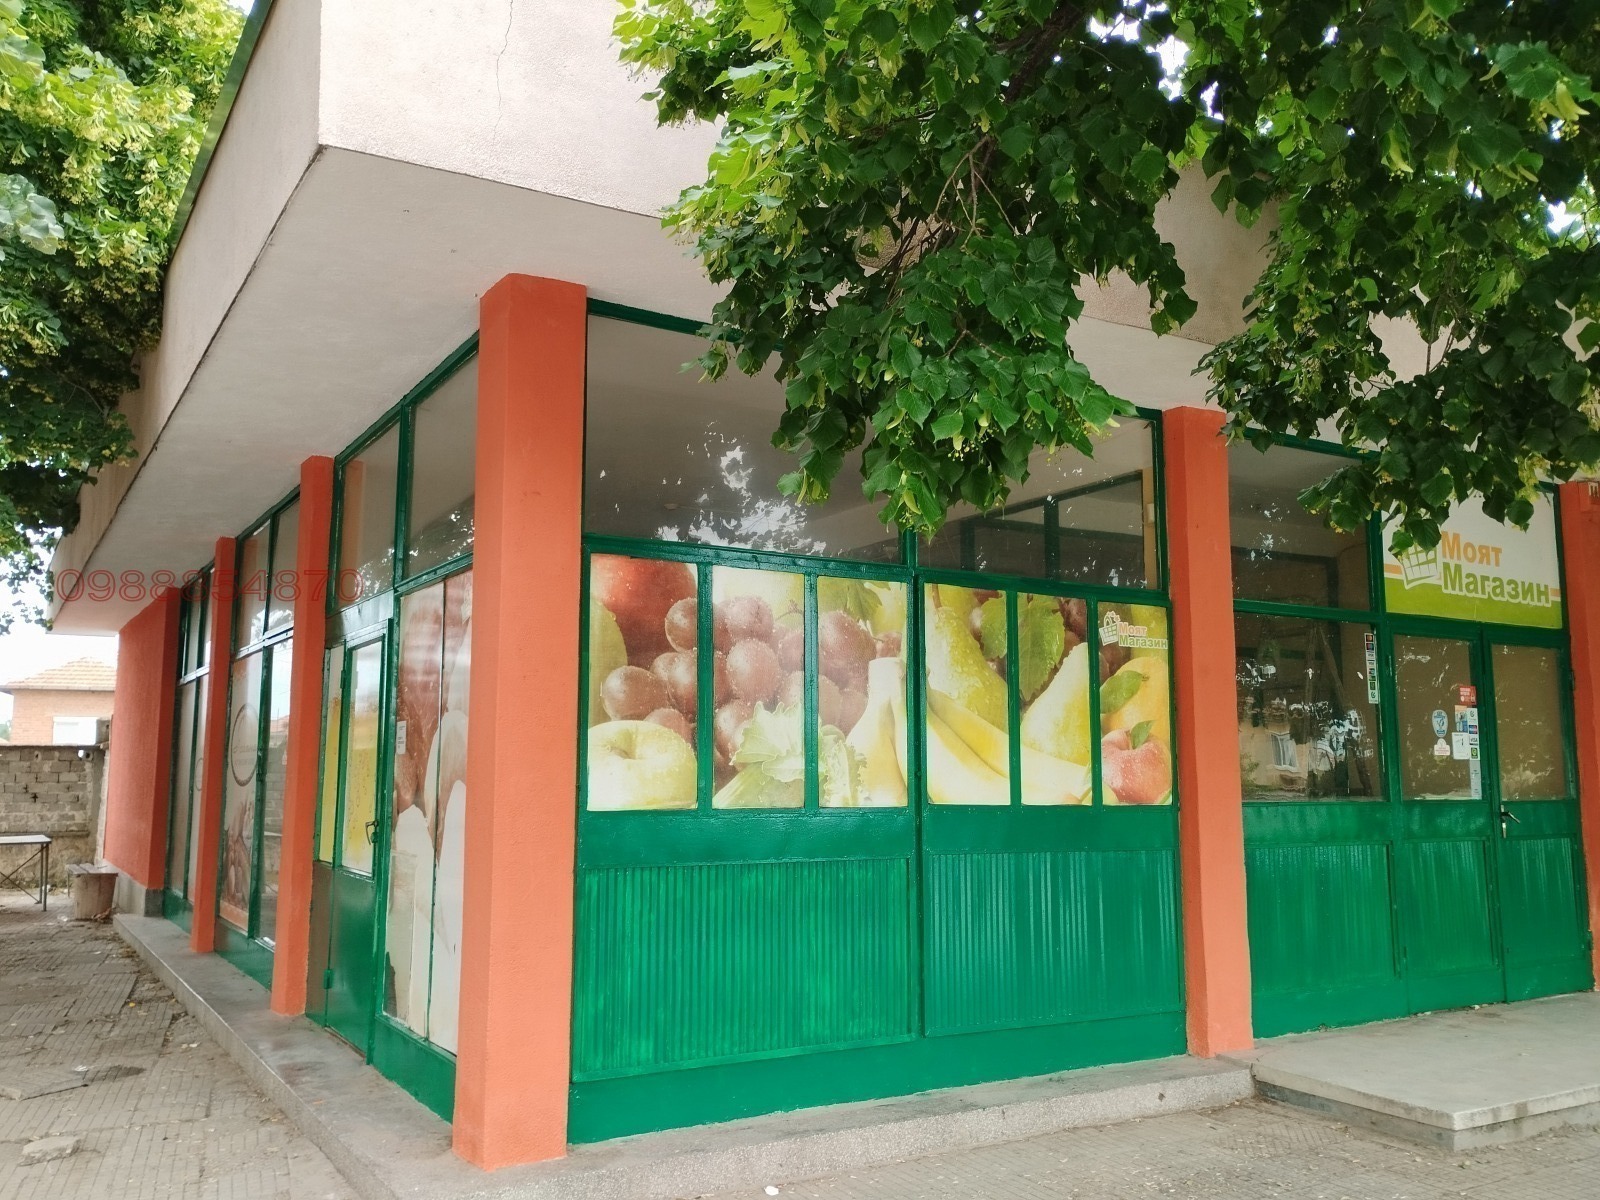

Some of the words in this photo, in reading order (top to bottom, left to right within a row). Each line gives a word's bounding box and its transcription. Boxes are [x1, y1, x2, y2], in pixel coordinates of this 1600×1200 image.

[1441, 530, 1502, 567] Моят
[1442, 562, 1549, 605] Магазин
[1119, 622, 1147, 636] Моят
[1119, 635, 1168, 649] Магазин
